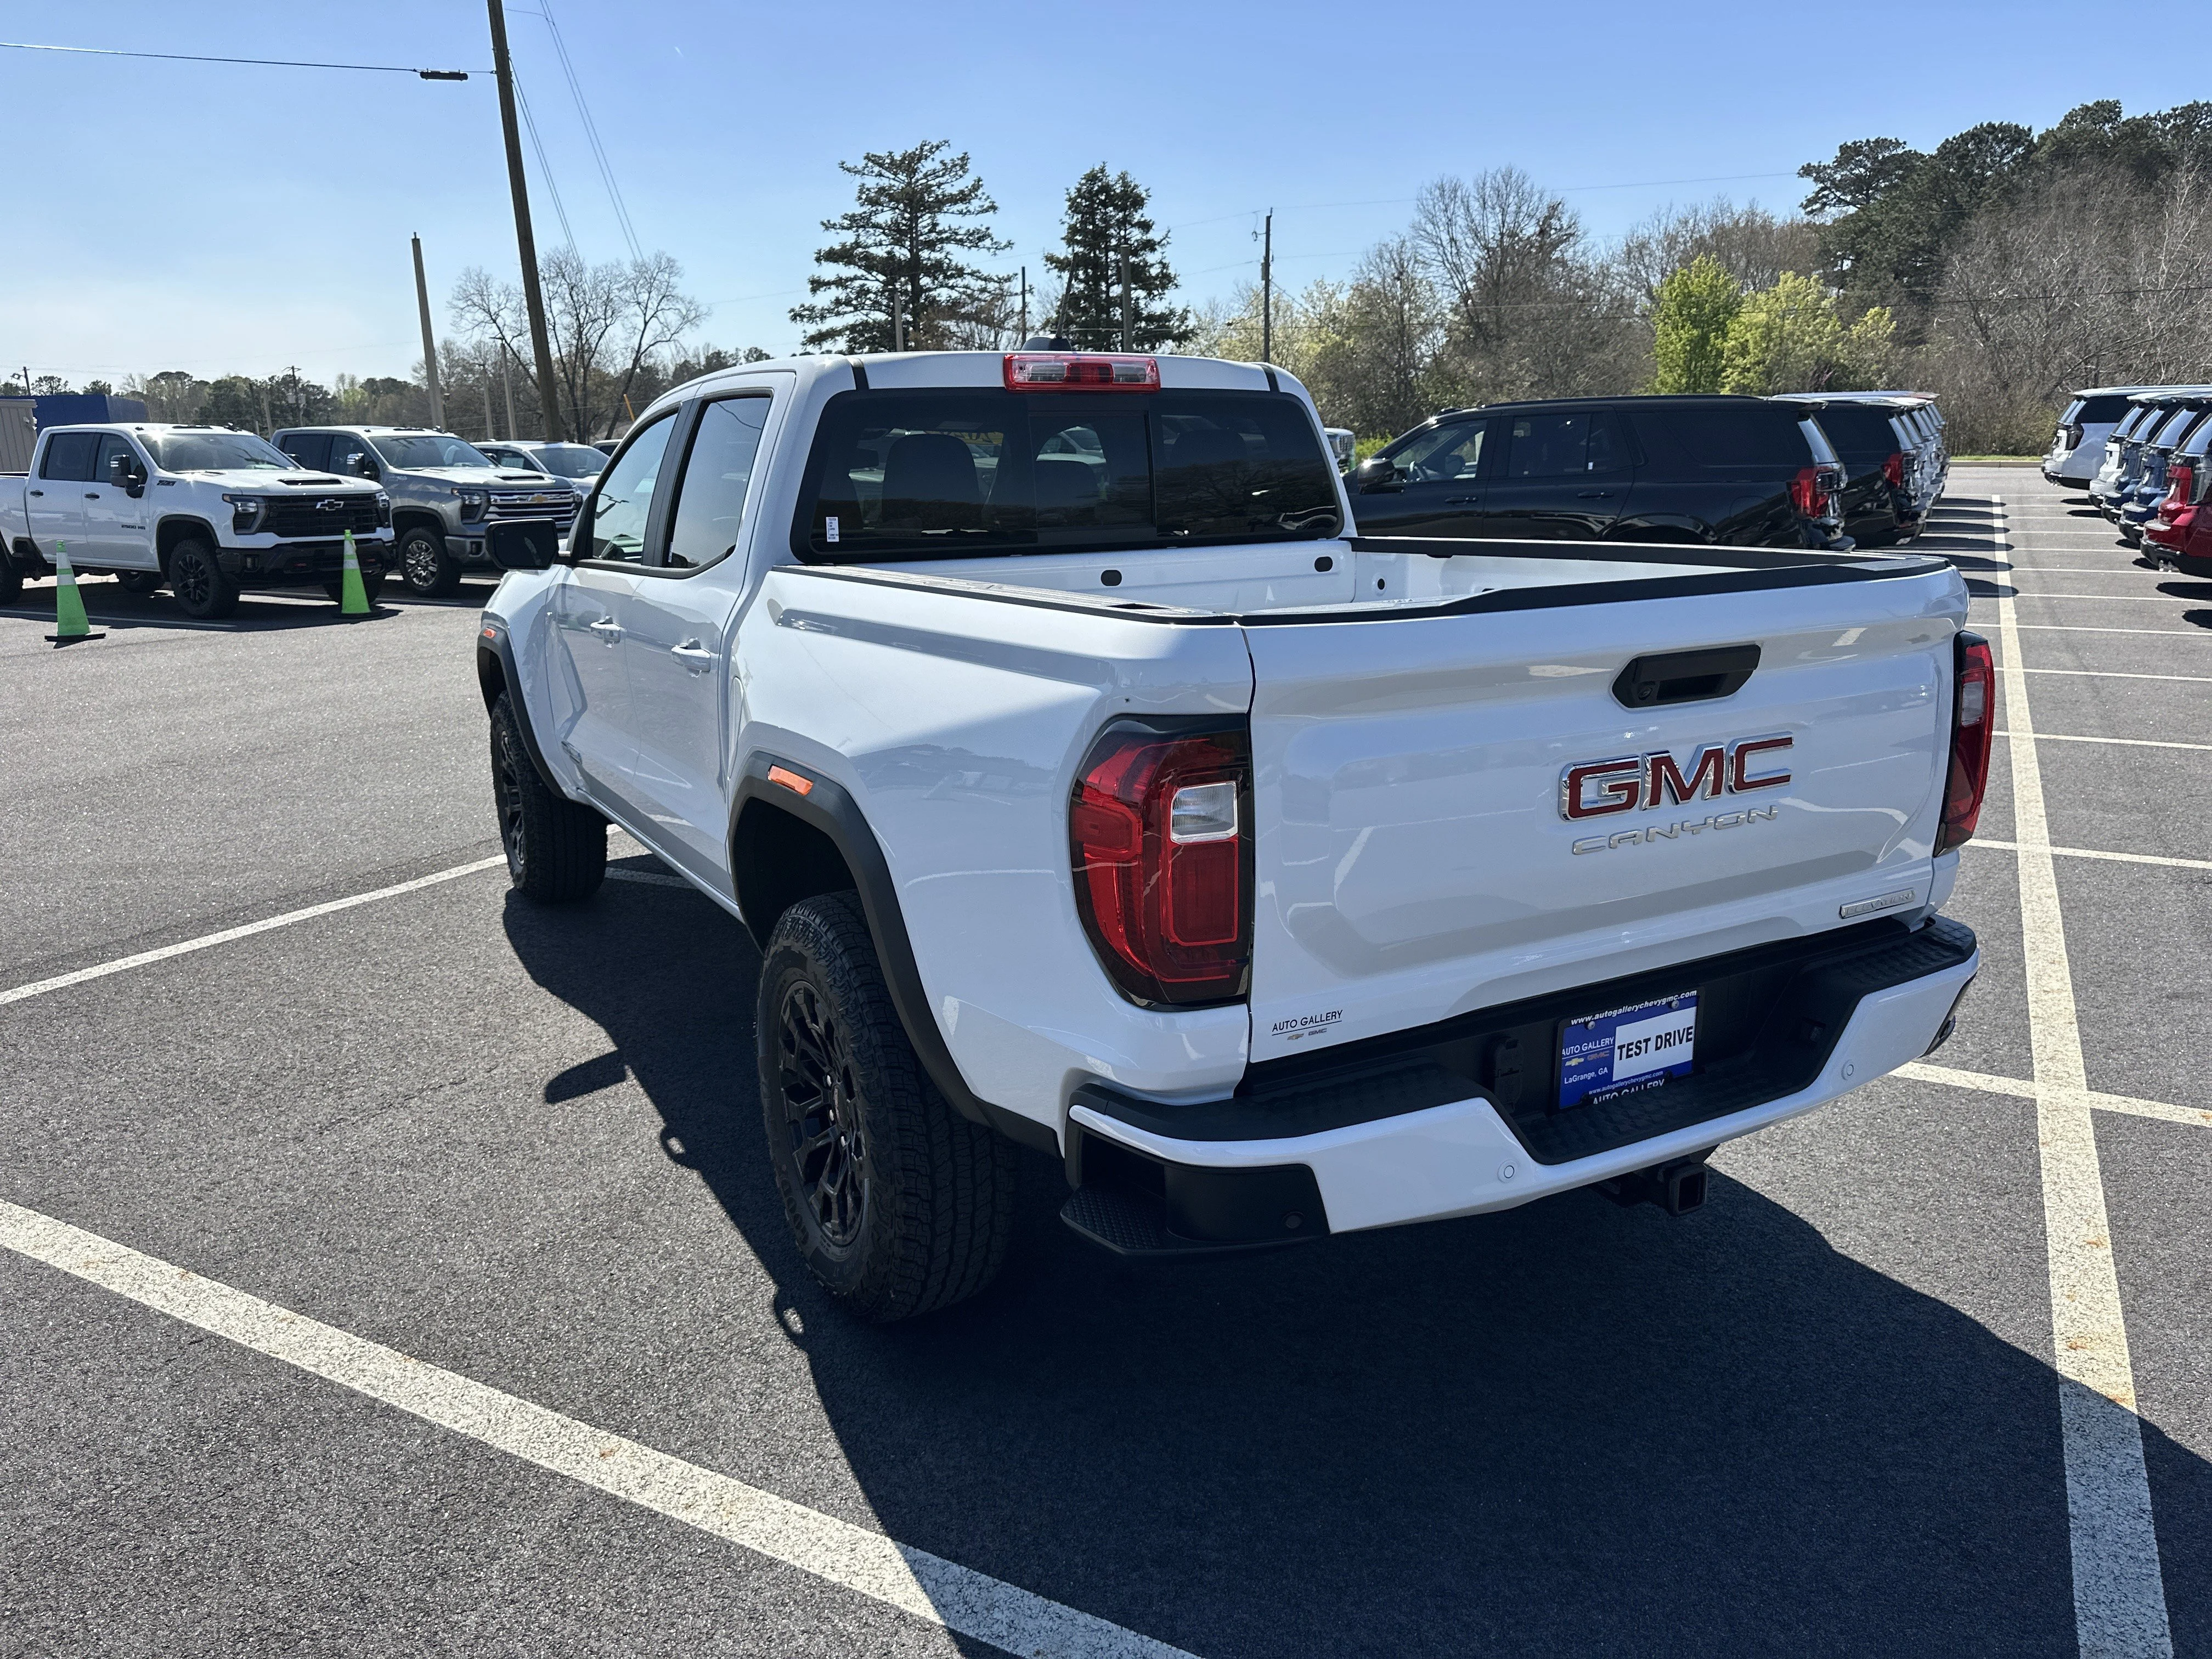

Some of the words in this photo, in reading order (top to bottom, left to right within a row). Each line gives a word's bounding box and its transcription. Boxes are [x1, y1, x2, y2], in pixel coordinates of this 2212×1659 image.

[1558, 731, 1794, 821] GMC
[1572, 805, 1778, 855] CANYON
[1272, 1019, 1297, 1032] AUTO
[1300, 1009, 1342, 1026] GALLERY
[1571, 990, 1697, 1025] www.autogallerychevygmc.com
[1562, 1045, 1580, 1056] AUTO
[1582, 1037, 1614, 1051] GALLERY
[1617, 1037, 1651, 1060] TEST
[1655, 1026, 1693, 1051] DRIVE
[1564, 1071, 1596, 1084] LaGrange,
